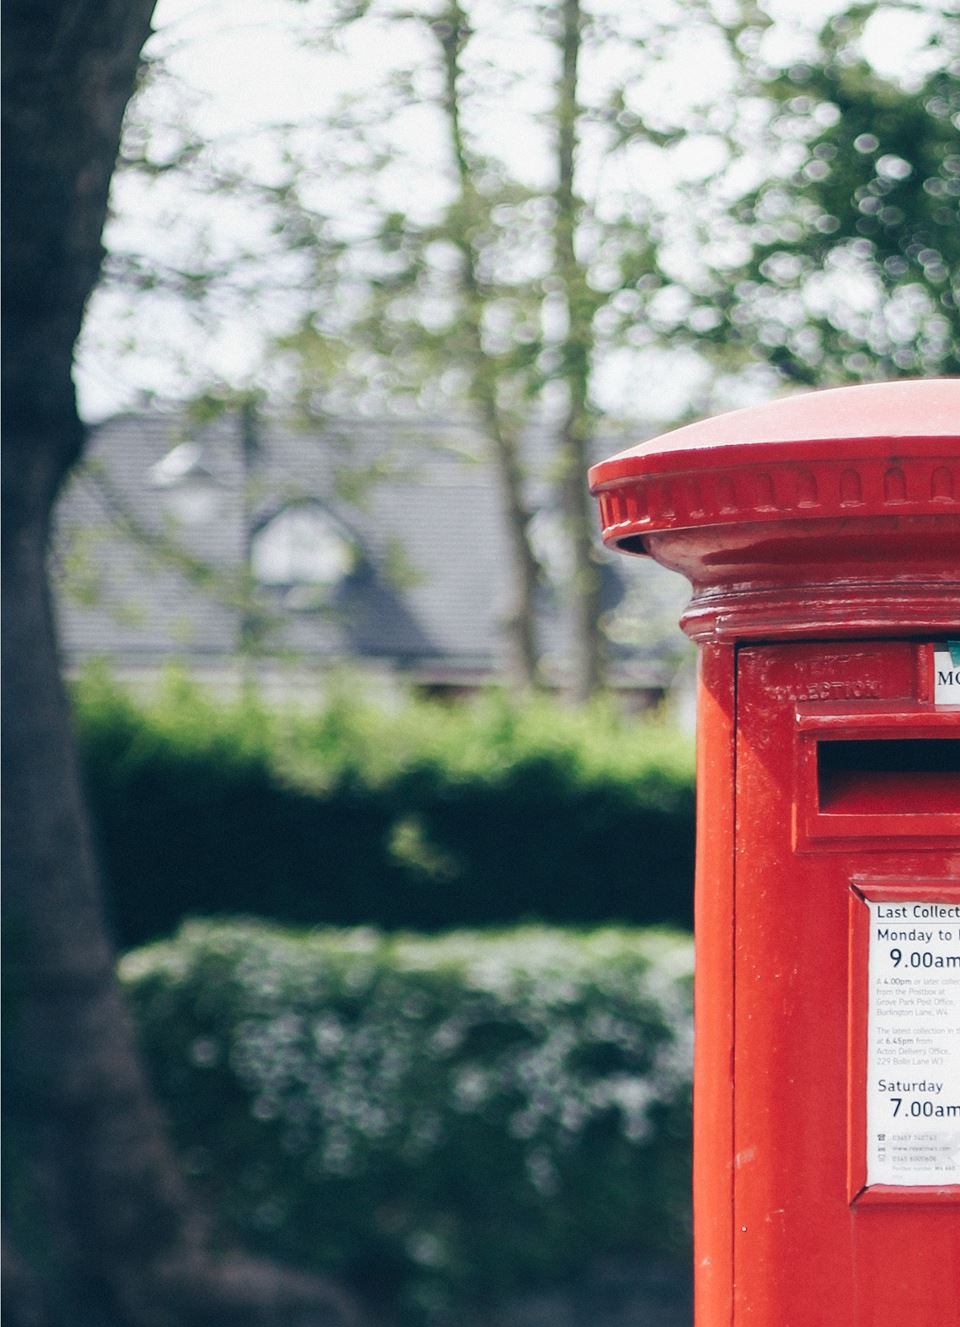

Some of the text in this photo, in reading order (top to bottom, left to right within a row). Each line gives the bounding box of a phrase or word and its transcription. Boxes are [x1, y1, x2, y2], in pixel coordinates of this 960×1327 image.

[877, 906, 907, 918] Last
[877, 929, 933, 943] Monday
[938, 930, 952, 941] to
[912, 1027, 946, 1035] collection
[877, 1079, 943, 1095] Saturday
